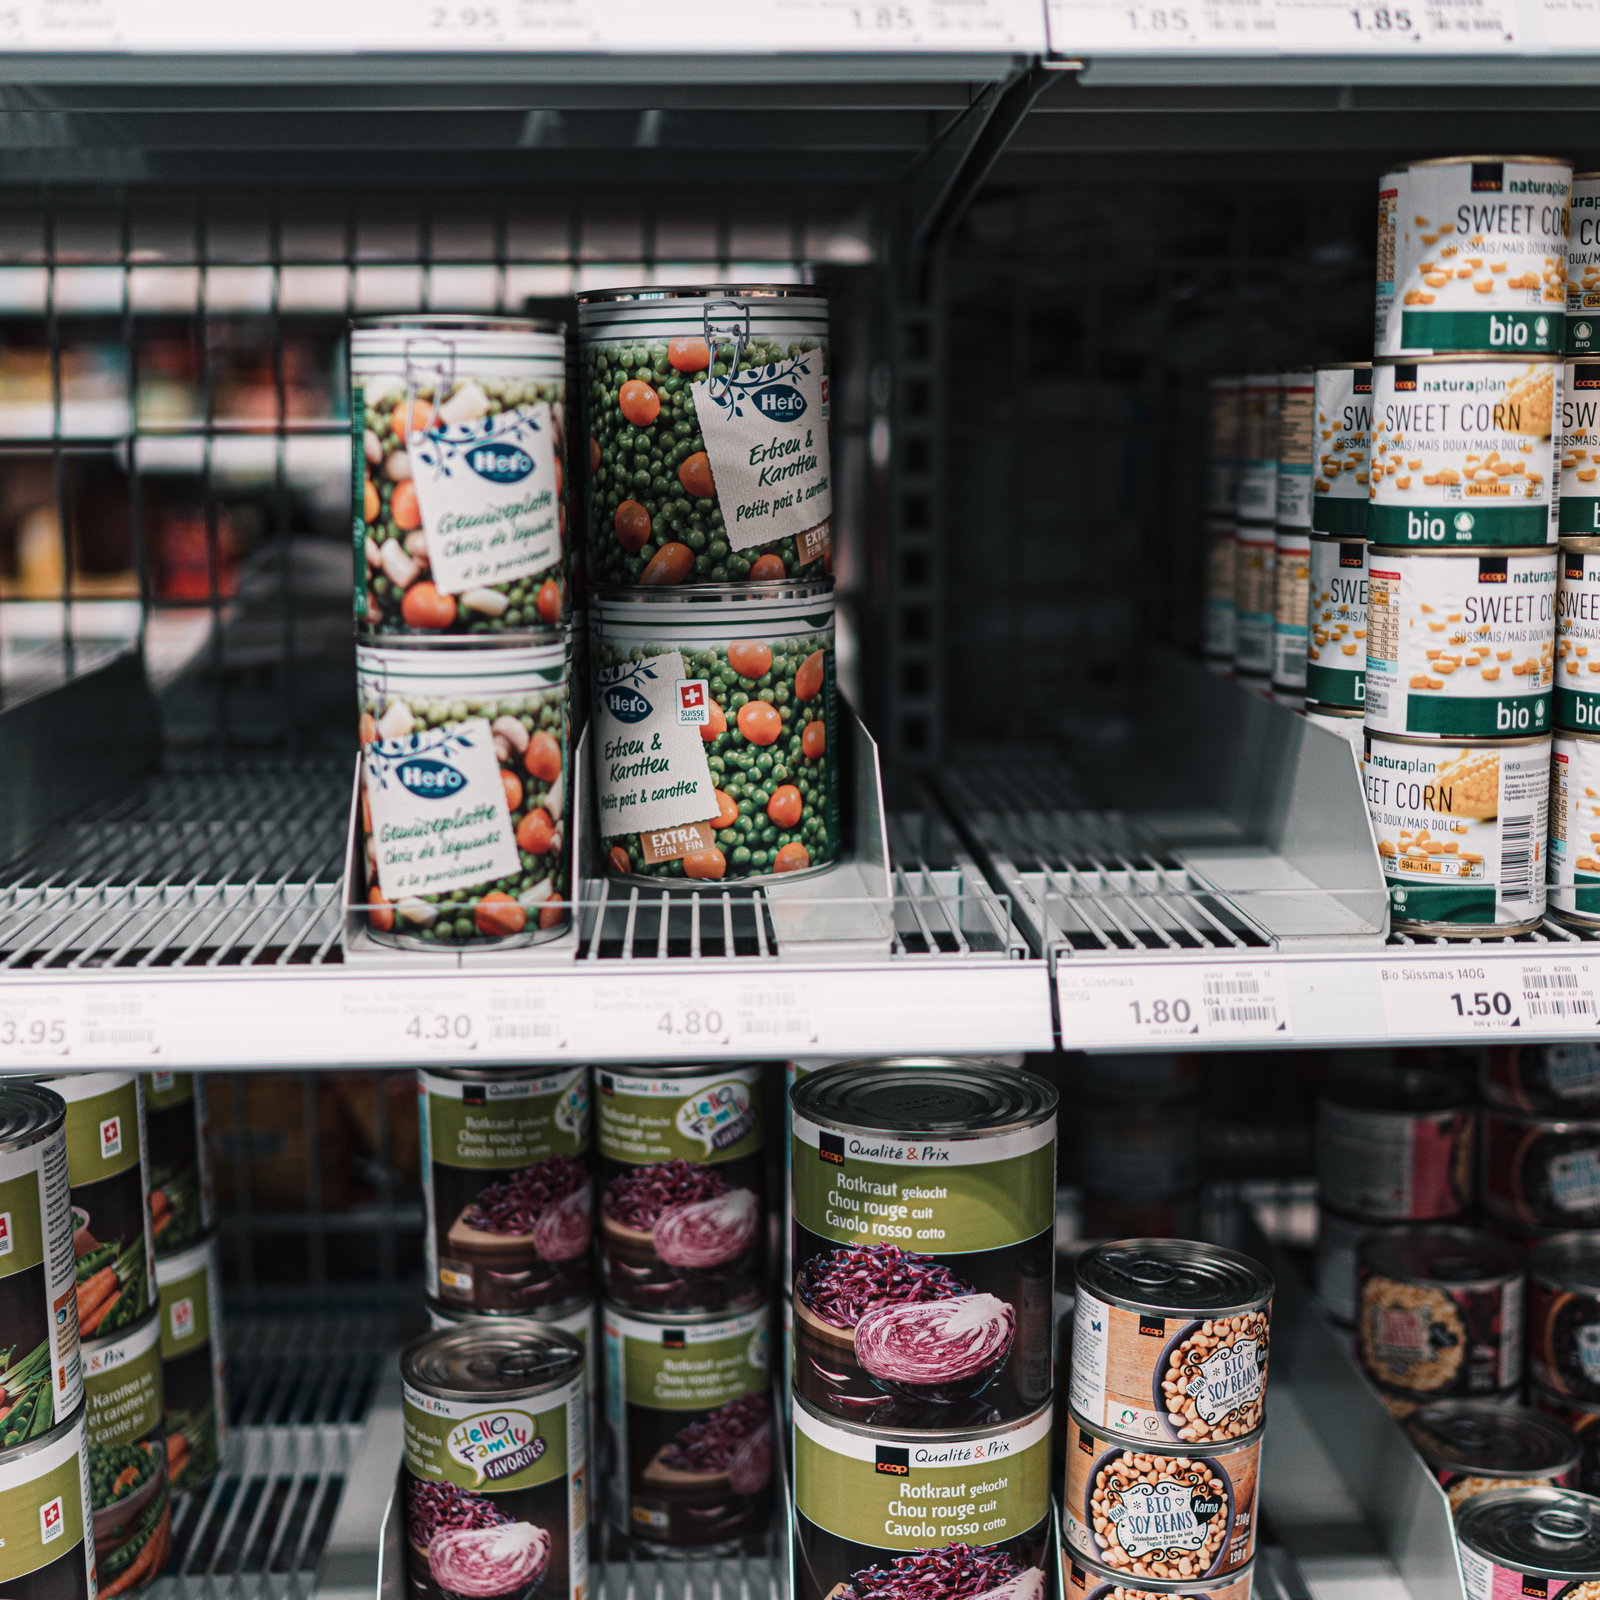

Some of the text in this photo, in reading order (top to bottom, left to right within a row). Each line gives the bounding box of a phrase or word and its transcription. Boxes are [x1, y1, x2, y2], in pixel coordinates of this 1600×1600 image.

[431, 8, 498, 28] 2.95
[852, 10, 913, 29] 1.85
[1128, 11, 1190, 32] 1.85
[1352, 10, 1412, 31] 1.85
[1457, 204, 1535, 235] SWEET
[1490, 315, 1528, 346] bio
[1395, 381, 1416, 390] coop
[1423, 377, 1506, 394] naturaplan
[762, 392, 804, 411] Hero
[1385, 404, 1521, 432] SWEET CORN
[749, 429, 813, 466] Erbsen &
[473, 450, 533, 474] Hero
[758, 453, 817, 487] Karotten
[736, 501, 770, 522] Petits
[773, 495, 793, 517] pois
[796, 491, 803, 503] &
[1408, 511, 1444, 540] bio
[1456, 532, 1472, 540] BIO
[1341, 558, 1362, 566] coop
[1480, 573, 1506, 581] coop
[1566, 569, 1582, 578] coop
[1465, 596, 1532, 623] SWEET
[610, 693, 648, 714] Hero
[1497, 702, 1529, 729] bio
[605, 733, 662, 760] Erbsen &
[610, 757, 670, 783] Karotten
[1373, 755, 1436, 774] naturaplan
[403, 767, 463, 787] Hero
[619, 780, 698, 813] pois & carottes
[1396, 782, 1452, 813] CORN
[1432, 820, 1461, 832] DOLCE
[651, 827, 700, 848] EXTRA
[654, 839, 704, 857] FEIN FIN
[1394, 904, 1406, 912] BIO
[1081, 976, 1134, 988] Süssmais
[1381, 968, 1485, 981] Bio Süssmais 140G
[1203, 998, 1220, 1006] 104
[1450, 992, 1512, 1016] 1.50
[1522, 991, 1540, 1000] 104
[1129, 999, 1191, 1024] 1.80
[1, 1020, 66, 1044] 3.95
[406, 1015, 471, 1040] 4.30
[657, 1010, 723, 1036] 4.80
[820, 1150, 843, 1163] coop
[850, 1140, 950, 1161] Qualité & Prix
[837, 1173, 947, 1201] Rotkraut gekocht
[828, 1191, 933, 1222] Chou rouge cuit
[826, 1210, 945, 1239] Cavolo rosso cotto
[1140, 1326, 1163, 1336] coop
[90, 1349, 125, 1371] & Prix
[1225, 1355, 1244, 1376] BIO
[93, 1377, 140, 1408] Karotten
[1187, 1378, 1205, 1396] VEGAN
[1208, 1362, 1256, 1402] SOY BEANS
[433, 1401, 450, 1415] Prix
[453, 1416, 509, 1447] Hello
[459, 1430, 527, 1462] Family
[915, 1441, 1010, 1463] Qualité & Prix
[1080, 1442, 1093, 1454] coop
[487, 1441, 545, 1478] FAVORITES
[877, 1462, 908, 1475] coop
[900, 1478, 1008, 1499] Rotkraut gekocht
[888, 1500, 997, 1520] Chou rouge cuit
[1110, 1508, 1126, 1521] VEGAN
[1146, 1497, 1172, 1513] BIO
[1194, 1501, 1218, 1513] Karma
[45, 1523, 60, 1535] SUISSE
[885, 1517, 1006, 1537] Cavolo rosso cotto
[1128, 1511, 1194, 1534] SOY BEANS
[1071, 1574, 1085, 1587] coop
[1523, 1588, 1546, 1598] coop
